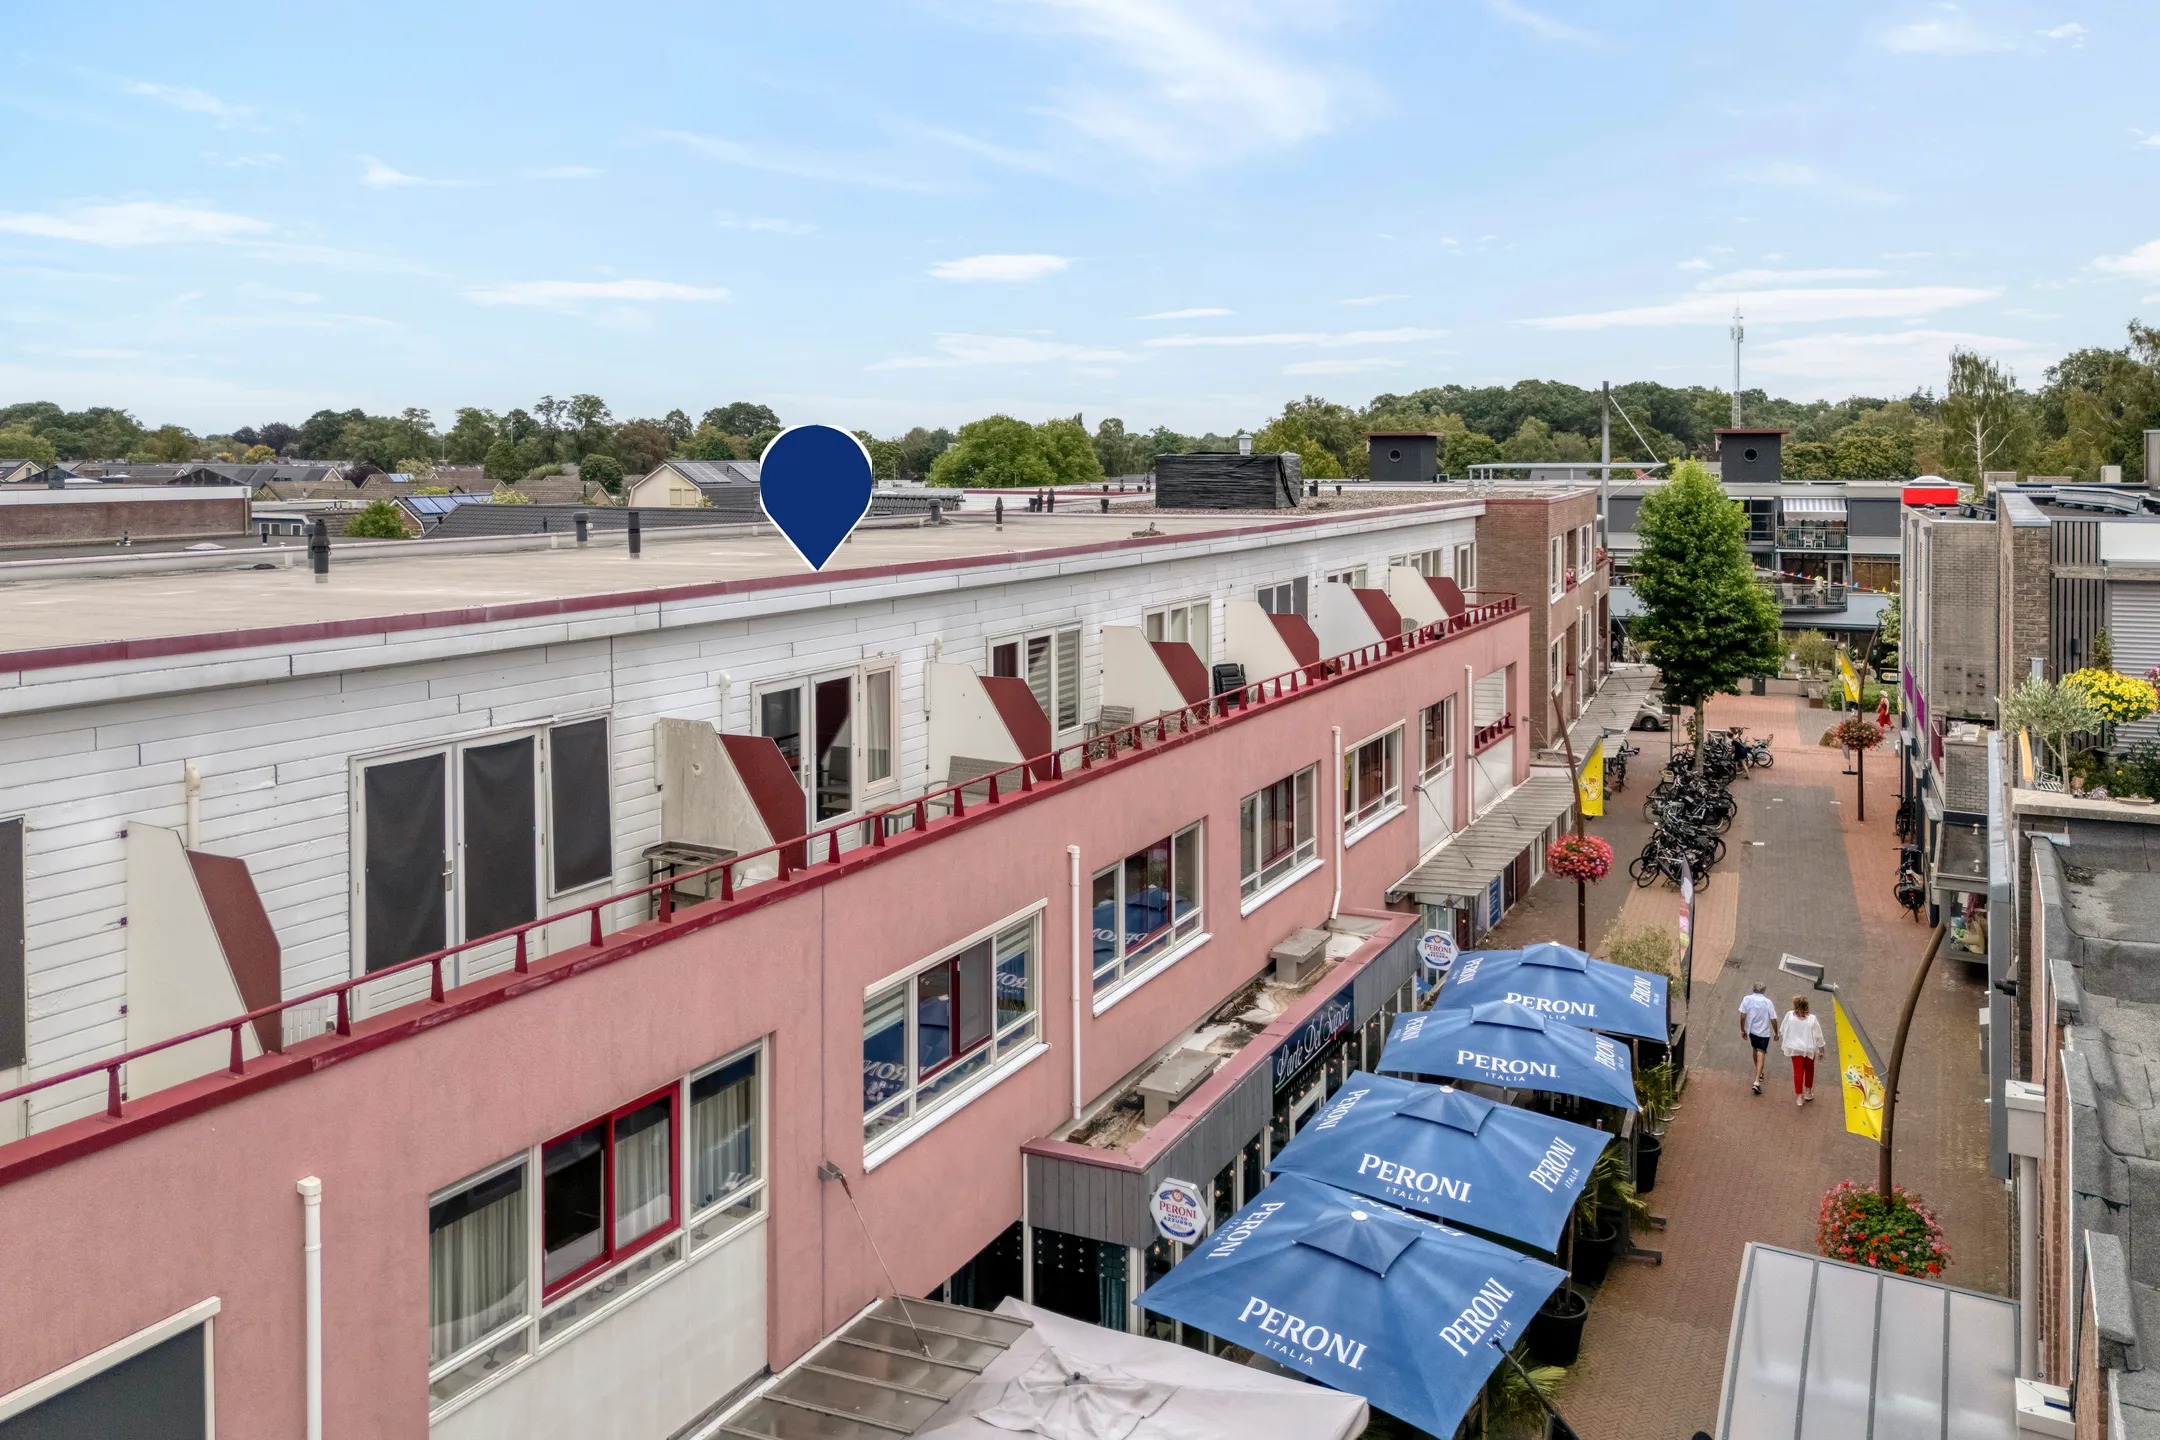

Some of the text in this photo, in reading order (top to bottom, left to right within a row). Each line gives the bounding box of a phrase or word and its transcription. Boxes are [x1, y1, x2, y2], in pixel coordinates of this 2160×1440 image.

[1425, 944, 1451, 953] PERONI
[1503, 992, 1598, 1017] PERONI
[1629, 975, 1652, 1008] PERONI
[1456, 1050, 1560, 1079] PERONI
[1485, 1072, 1526, 1082] ITALIA
[1315, 1089, 1371, 1132] PERONI
[1357, 1153, 1472, 1203] PERONI
[1528, 1136, 1577, 1193] PERONI
[1564, 1168, 1581, 1189] ITALIA
[1386, 1186, 1430, 1204] ITALIA
[1160, 1201, 1197, 1219] PERONI
[1206, 1201, 1286, 1260] PERONI
[1214, 1218, 1242, 1241] ITALIA
[1439, 1277, 1516, 1357] PERONI
[1238, 1296, 1368, 1370] PERONI
[1265, 1339, 1313, 1366] ITALIA
